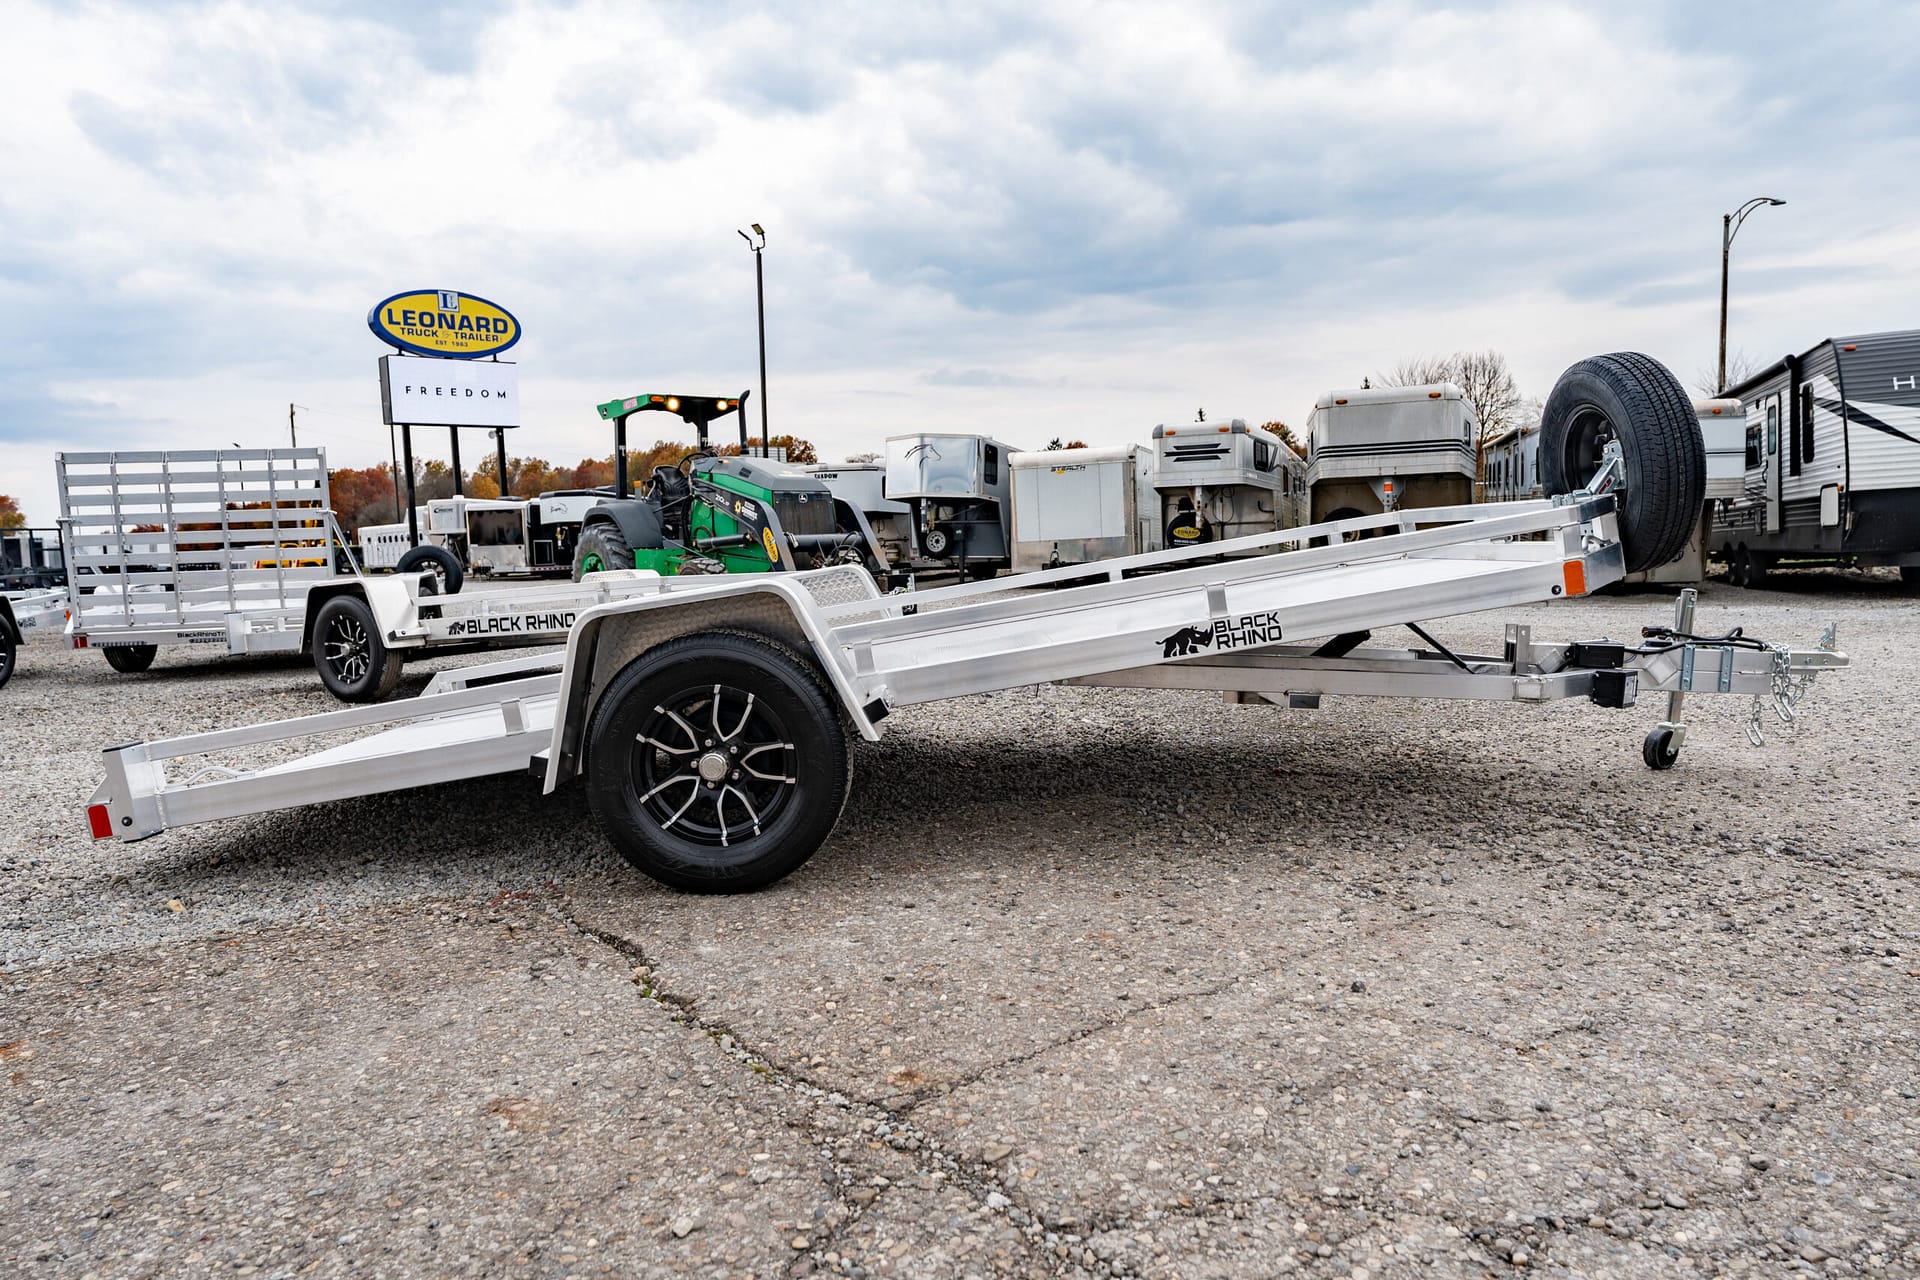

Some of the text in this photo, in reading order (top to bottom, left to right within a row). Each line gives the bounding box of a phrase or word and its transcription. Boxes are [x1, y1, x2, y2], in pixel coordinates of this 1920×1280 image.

[387, 308, 509, 334] LEONARD
[400, 327, 439, 338] TRUCK
[454, 331, 499, 343] TRAILER
[405, 385, 507, 399] FREEDOM
[466, 612, 576, 635] BLACK RHINO
[1213, 611, 1280, 634] BLACK
[1215, 625, 1283, 650] RHINO
